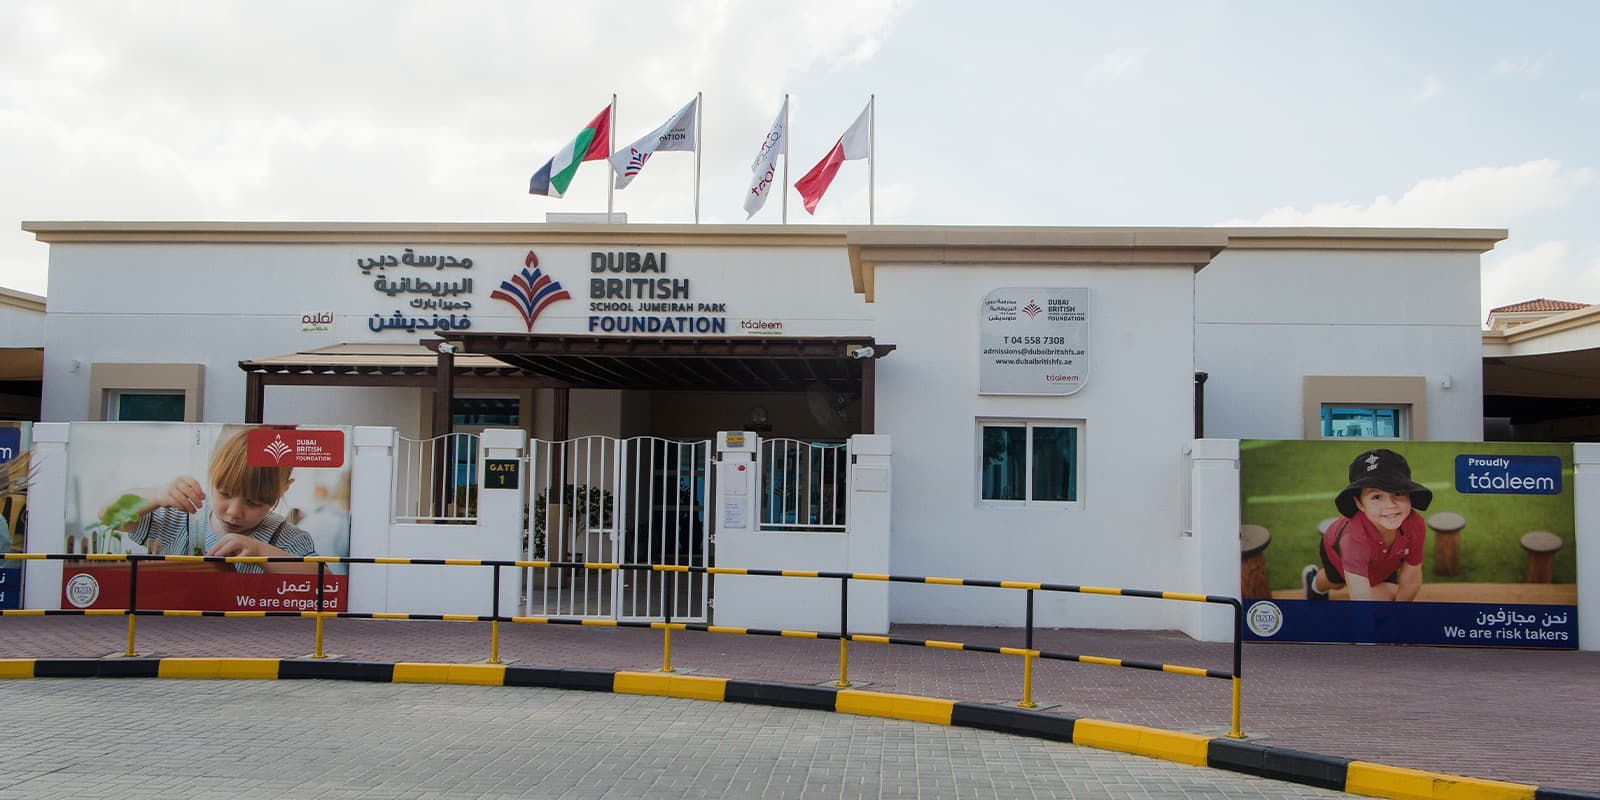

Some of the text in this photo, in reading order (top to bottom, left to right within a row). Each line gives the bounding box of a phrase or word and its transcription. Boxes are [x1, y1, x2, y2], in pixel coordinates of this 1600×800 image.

[357, 248, 473, 275] مدرسة دبي
[591, 252, 667, 273] DUBAI
[374, 275, 472, 296] البريطانية
[590, 278, 689, 299] BRITISH
[590, 302, 726, 313] SCHOOL JUMEIRAH PARK
[368, 310, 471, 333] فاونديشن
[588, 316, 726, 333] FOUNDATION
[1003, 336, 1065, 345] T 04 558 7308
[490, 464, 515, 472] GATE
[1468, 457, 1510, 469] Proudly
[499, 474, 505, 485] 1
[277, 580, 311, 595] تعمل
[236, 595, 256, 607] We
[260, 598, 278, 608] are
[1476, 607, 1568, 627] نحن مجازفون
[1444, 626, 1569, 641] We are risk takers
